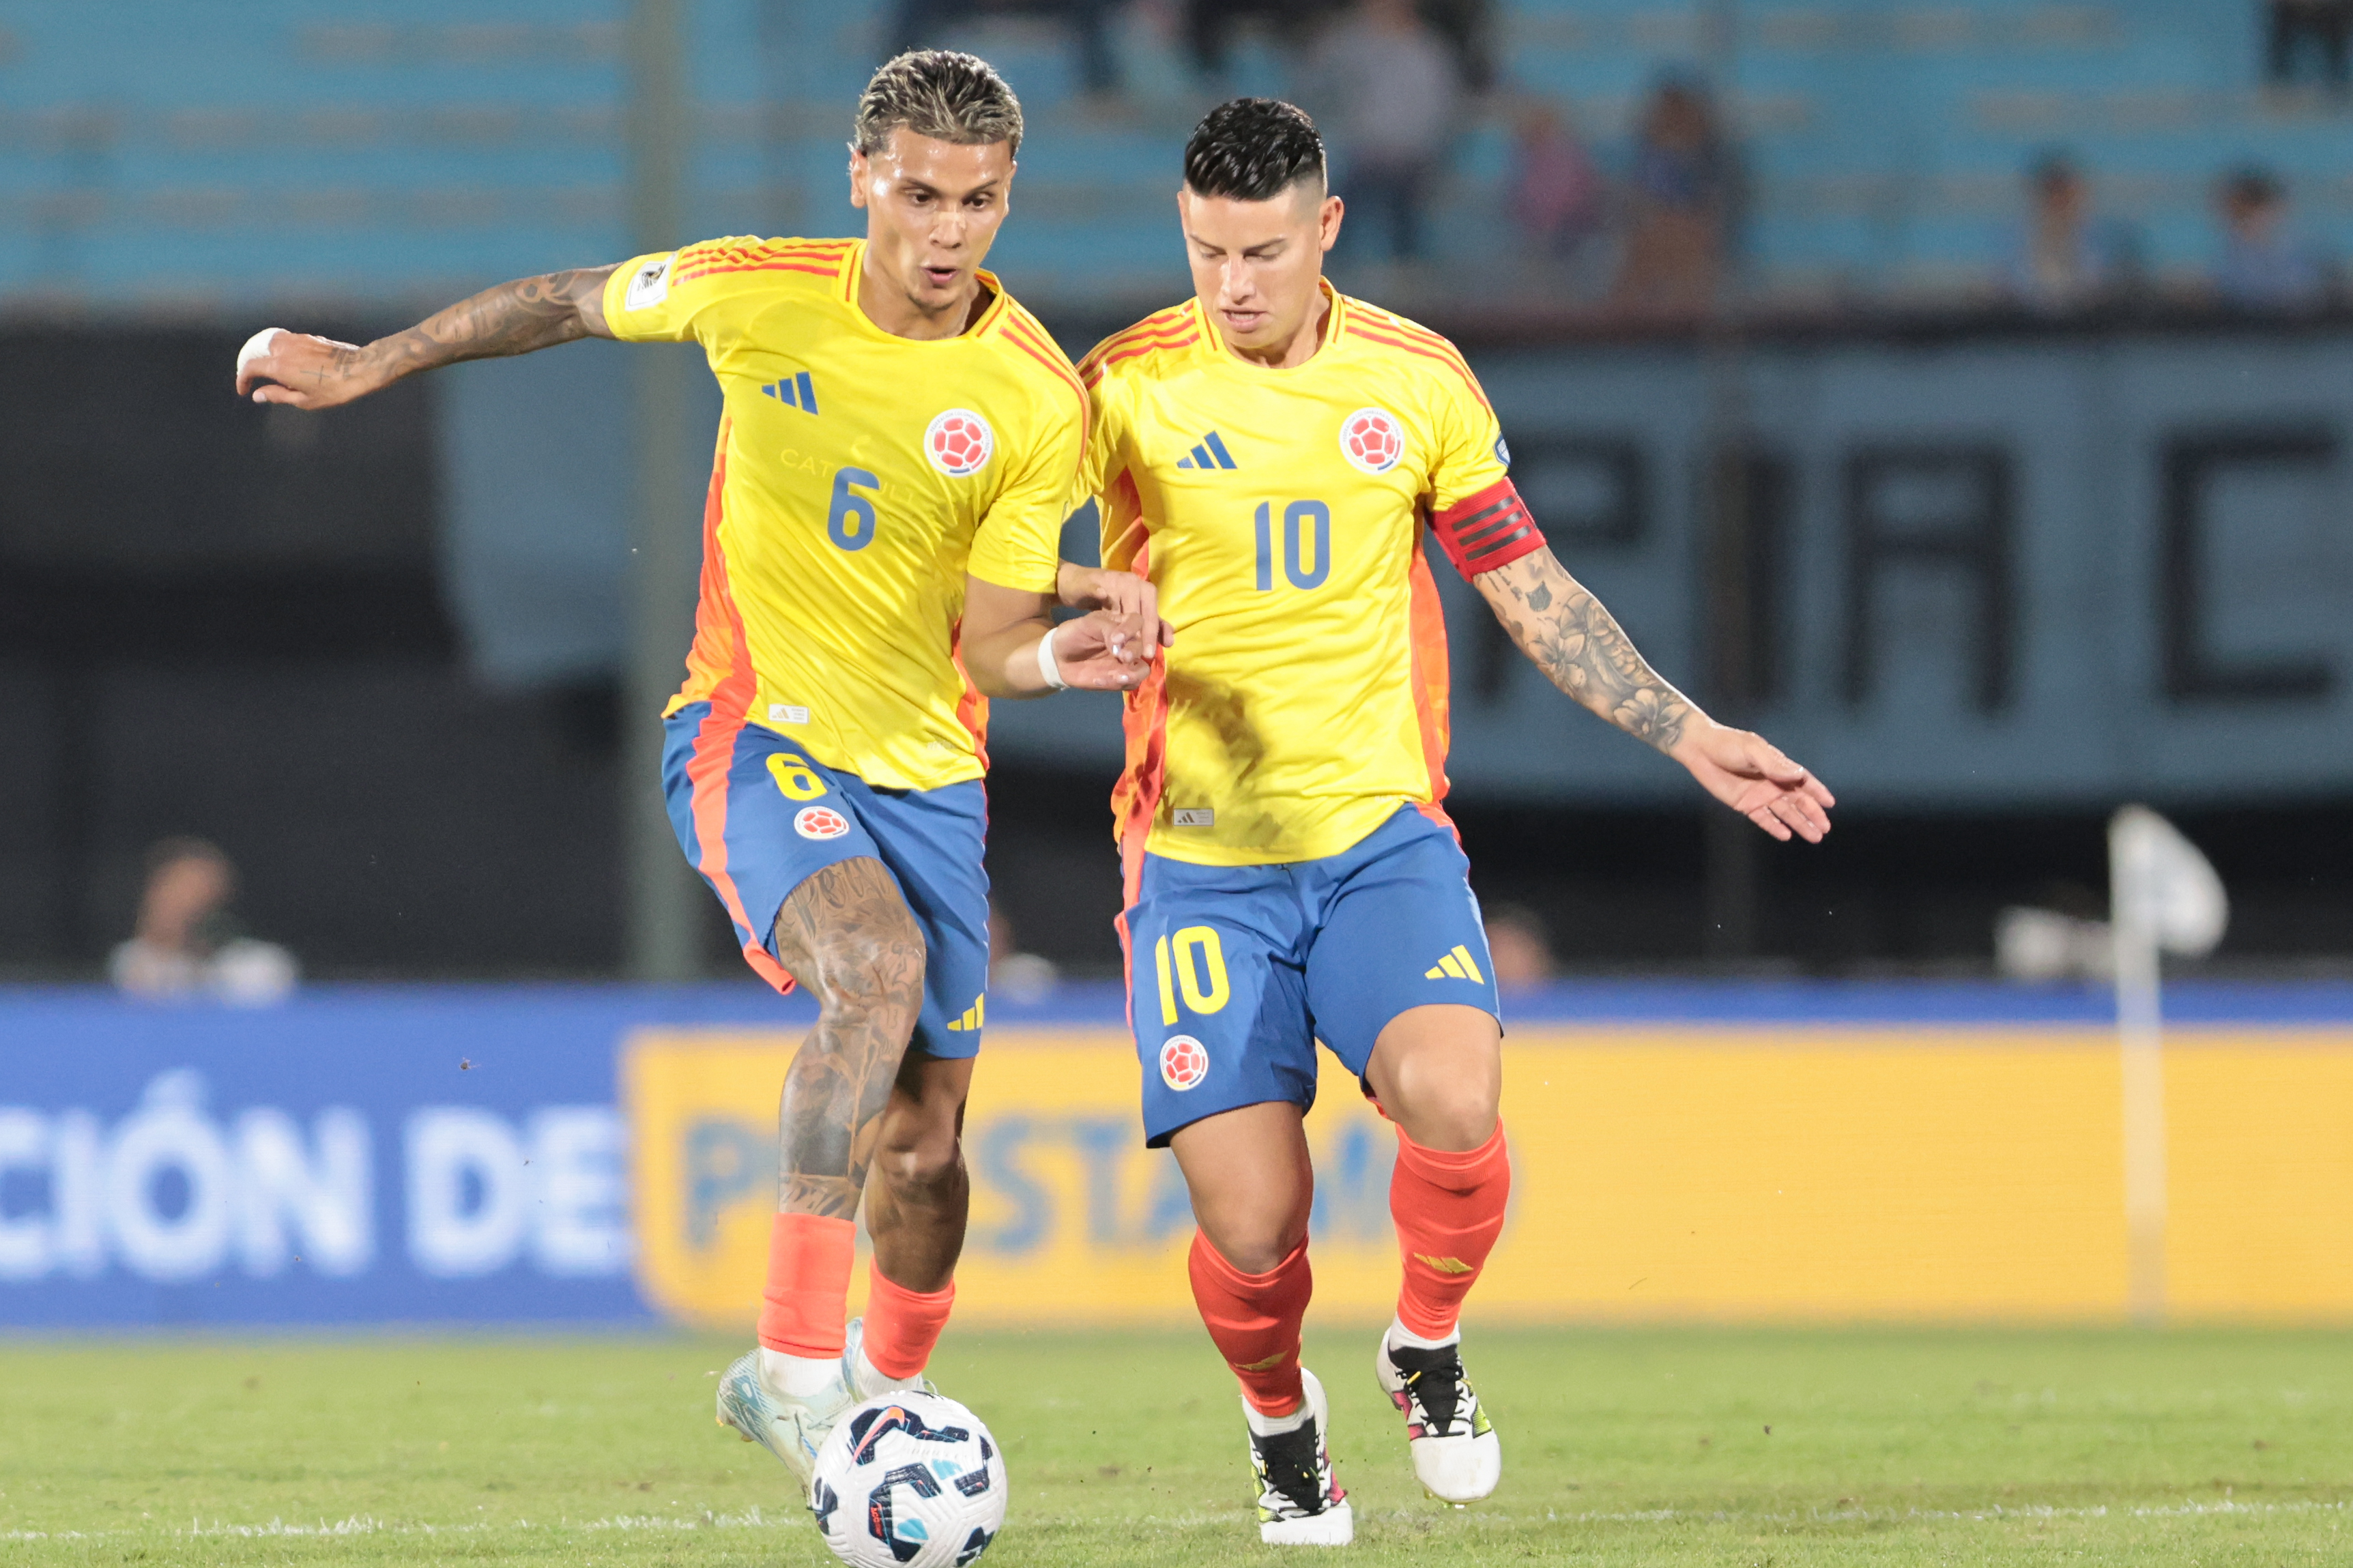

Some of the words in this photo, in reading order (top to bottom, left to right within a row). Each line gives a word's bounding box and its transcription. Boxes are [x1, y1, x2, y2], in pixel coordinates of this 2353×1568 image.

[828, 466, 880, 551] 6
[1254, 499, 1330, 591] 10
[766, 753, 827, 801] 6
[1155, 925, 1230, 1026] 10
[404, 1107, 626, 1277] DE
